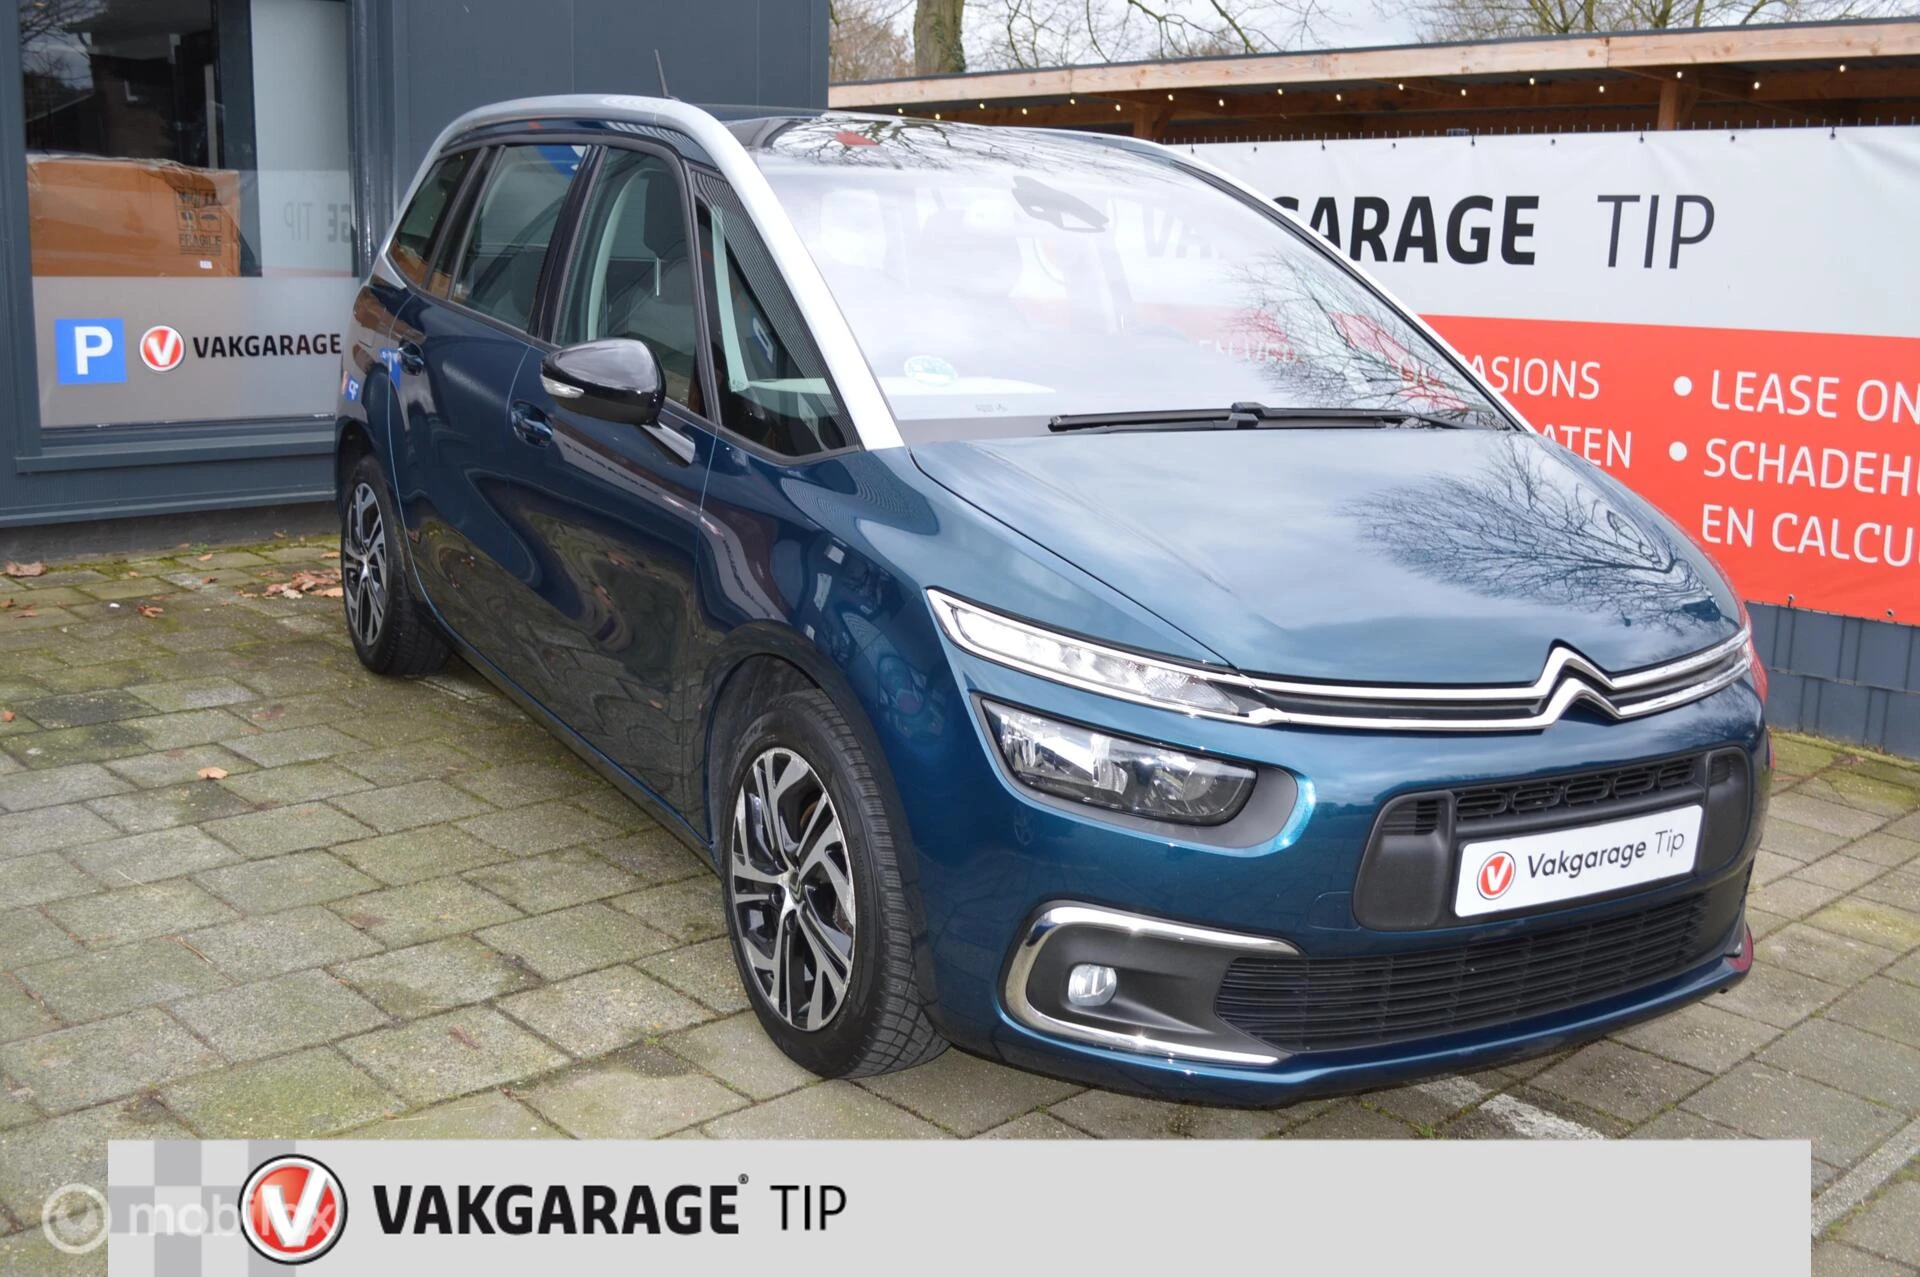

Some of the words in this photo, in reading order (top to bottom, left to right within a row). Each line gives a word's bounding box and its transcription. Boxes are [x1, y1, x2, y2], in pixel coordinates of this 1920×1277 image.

[1597, 194, 1715, 269] TIP
[74, 325, 113, 375] P
[193, 333, 342, 358] VAKGARAGE
[1471, 354, 1601, 400] ASIONS
[1711, 369, 1840, 419] LEASE
[1703, 437, 1920, 497] SCHADEH
[1702, 503, 1754, 548] EN
[1772, 512, 1920, 567] CALCU
[1527, 839, 1647, 879] Vakgarage
[1655, 829, 1684, 858] Tip
